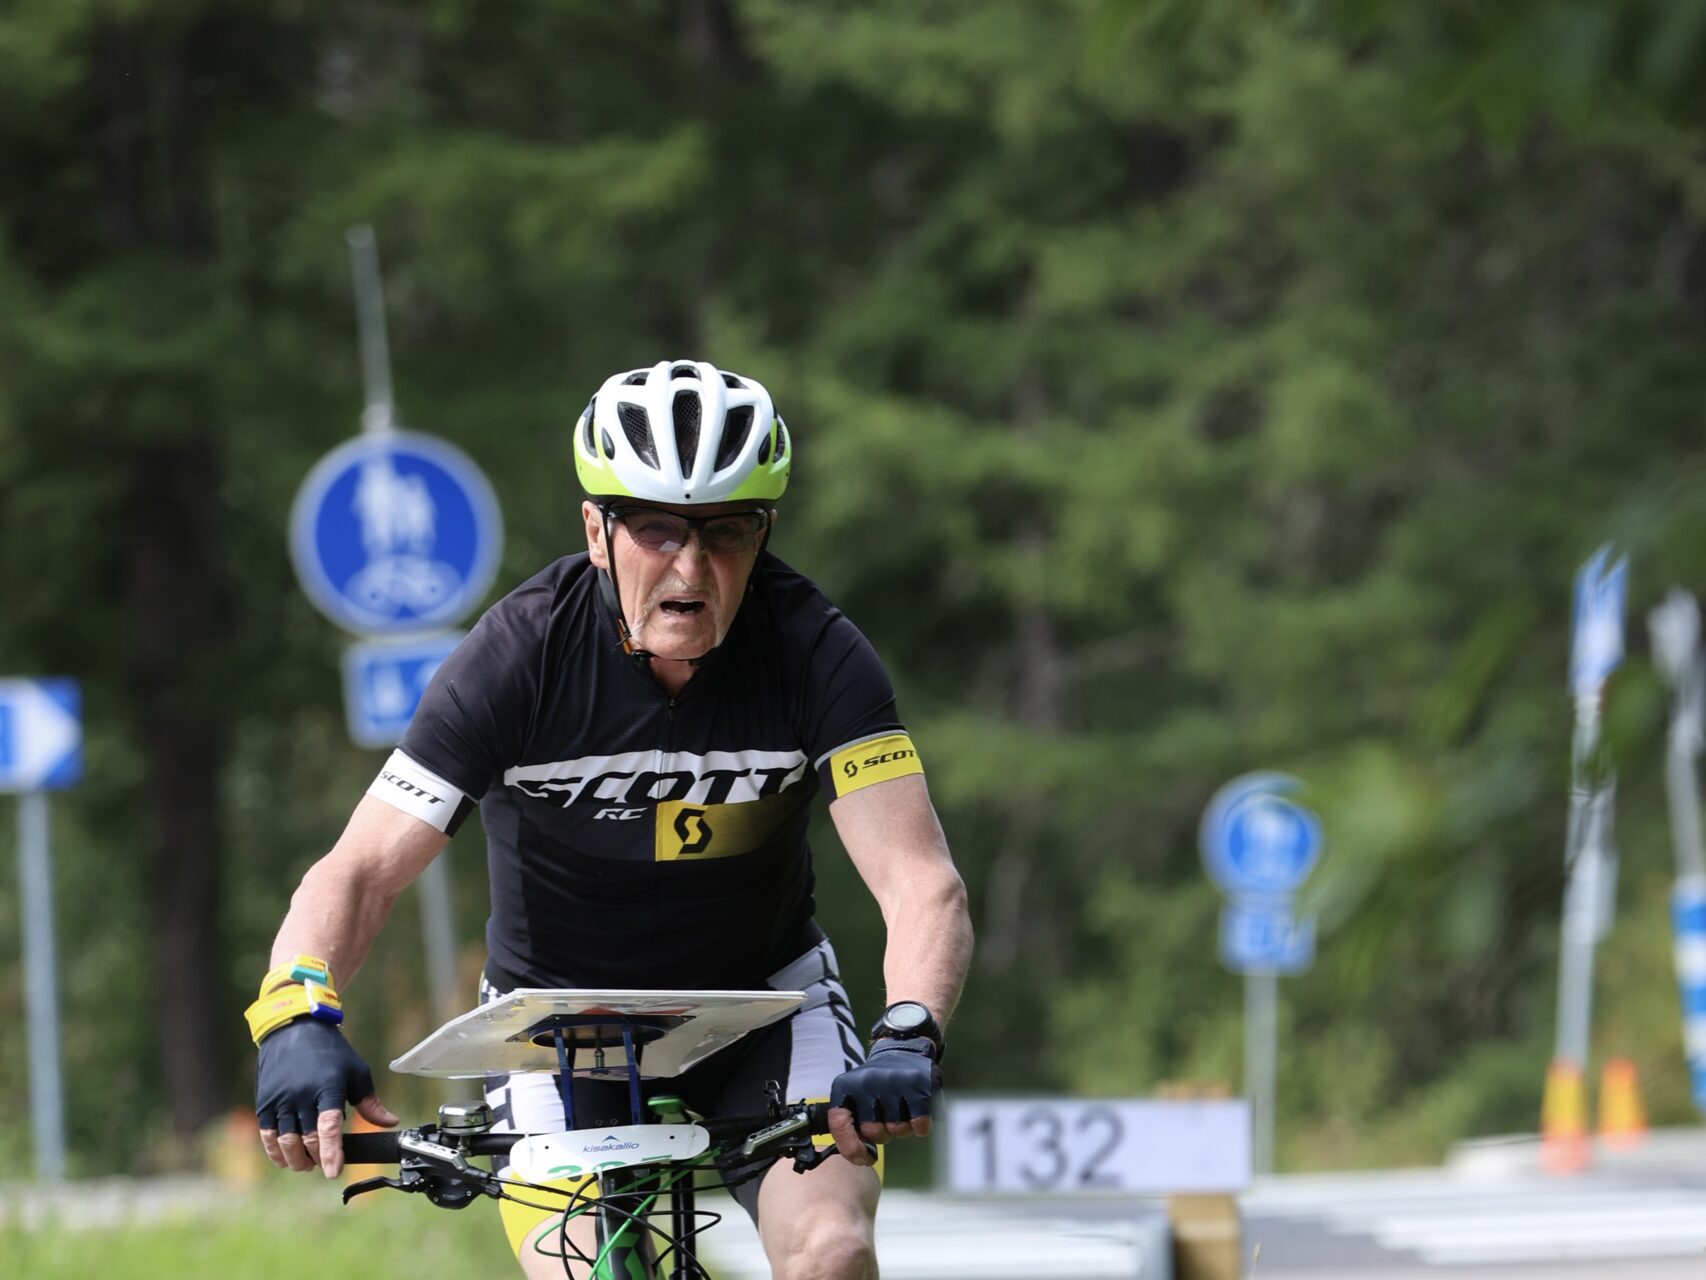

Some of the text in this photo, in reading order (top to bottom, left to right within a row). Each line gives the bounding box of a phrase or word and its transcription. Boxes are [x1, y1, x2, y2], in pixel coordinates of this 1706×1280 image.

[380, 771, 446, 804] SCOTT
[514, 766, 802, 806] SCOTT
[593, 807, 648, 821] RC
[582, 1142, 640, 1153] kisakallio
[968, 1107, 1126, 1188] 132
